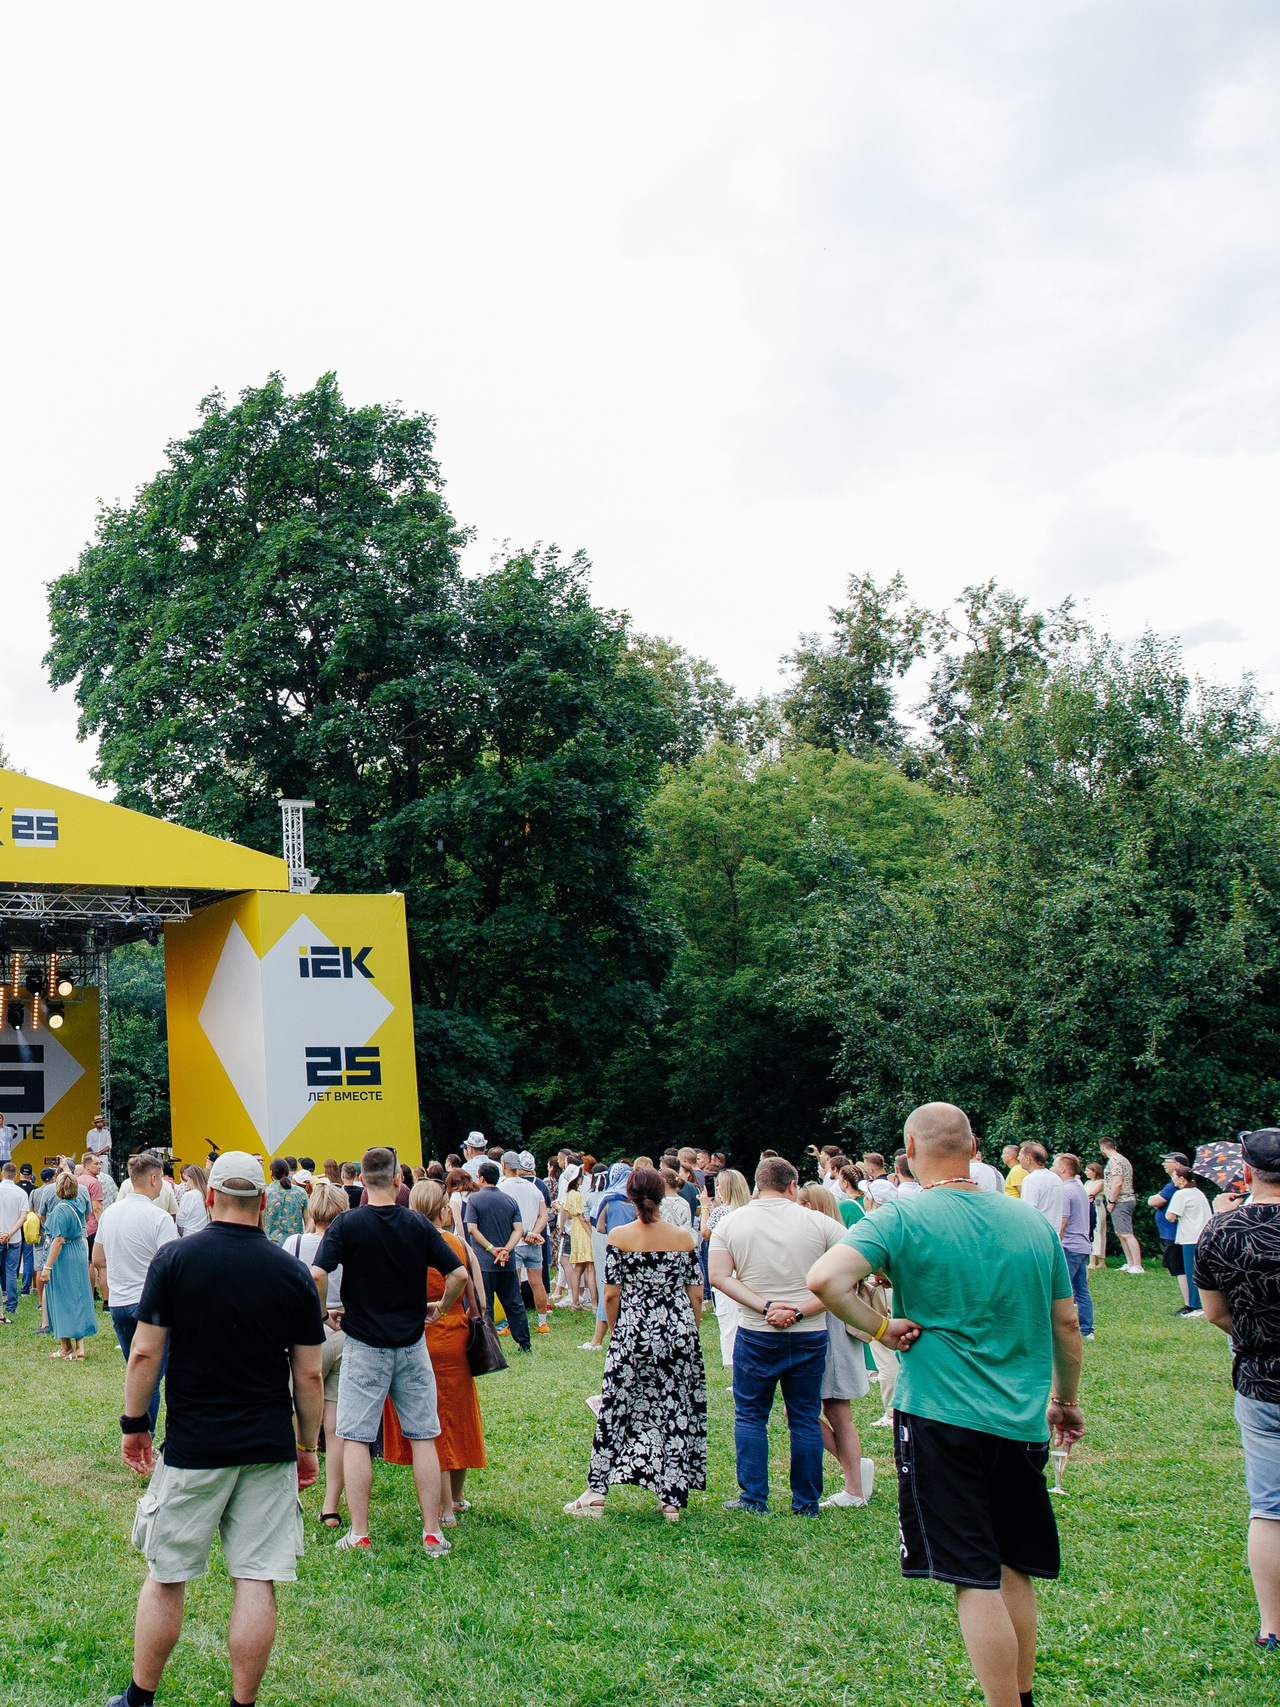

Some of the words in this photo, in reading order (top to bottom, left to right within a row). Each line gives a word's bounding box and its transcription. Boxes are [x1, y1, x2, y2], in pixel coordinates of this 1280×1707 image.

[11, 814, 59, 841] 25
[305, 1046, 382, 1087] 25
[307, 1091, 332, 1102] ЛЕТ
[334, 1090, 383, 1101] ВМЕСТЕ
